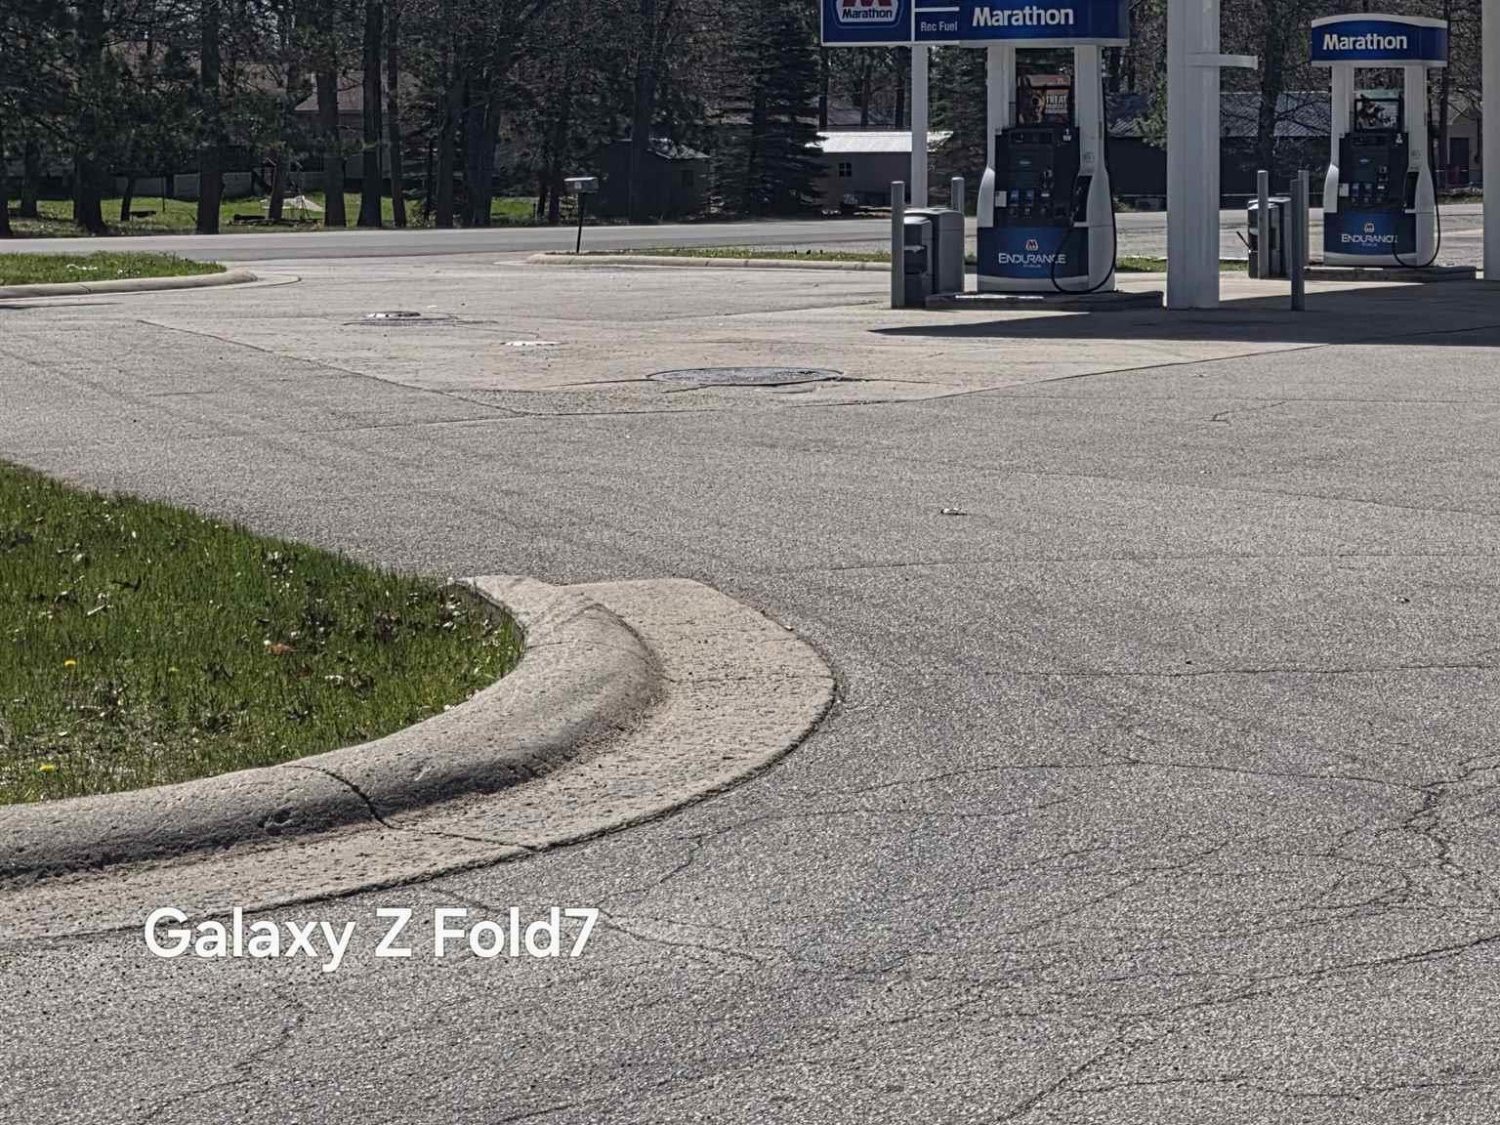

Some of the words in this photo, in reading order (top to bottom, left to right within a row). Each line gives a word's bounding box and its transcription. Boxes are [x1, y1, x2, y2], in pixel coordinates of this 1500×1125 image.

[843, 8, 893, 19] Marathon
[972, 5, 1075, 27] Marathon
[939, 21, 958, 32] Fuel
[1323, 33, 1408, 51] Marathon
[1341, 234, 1398, 243] ENDURANC
